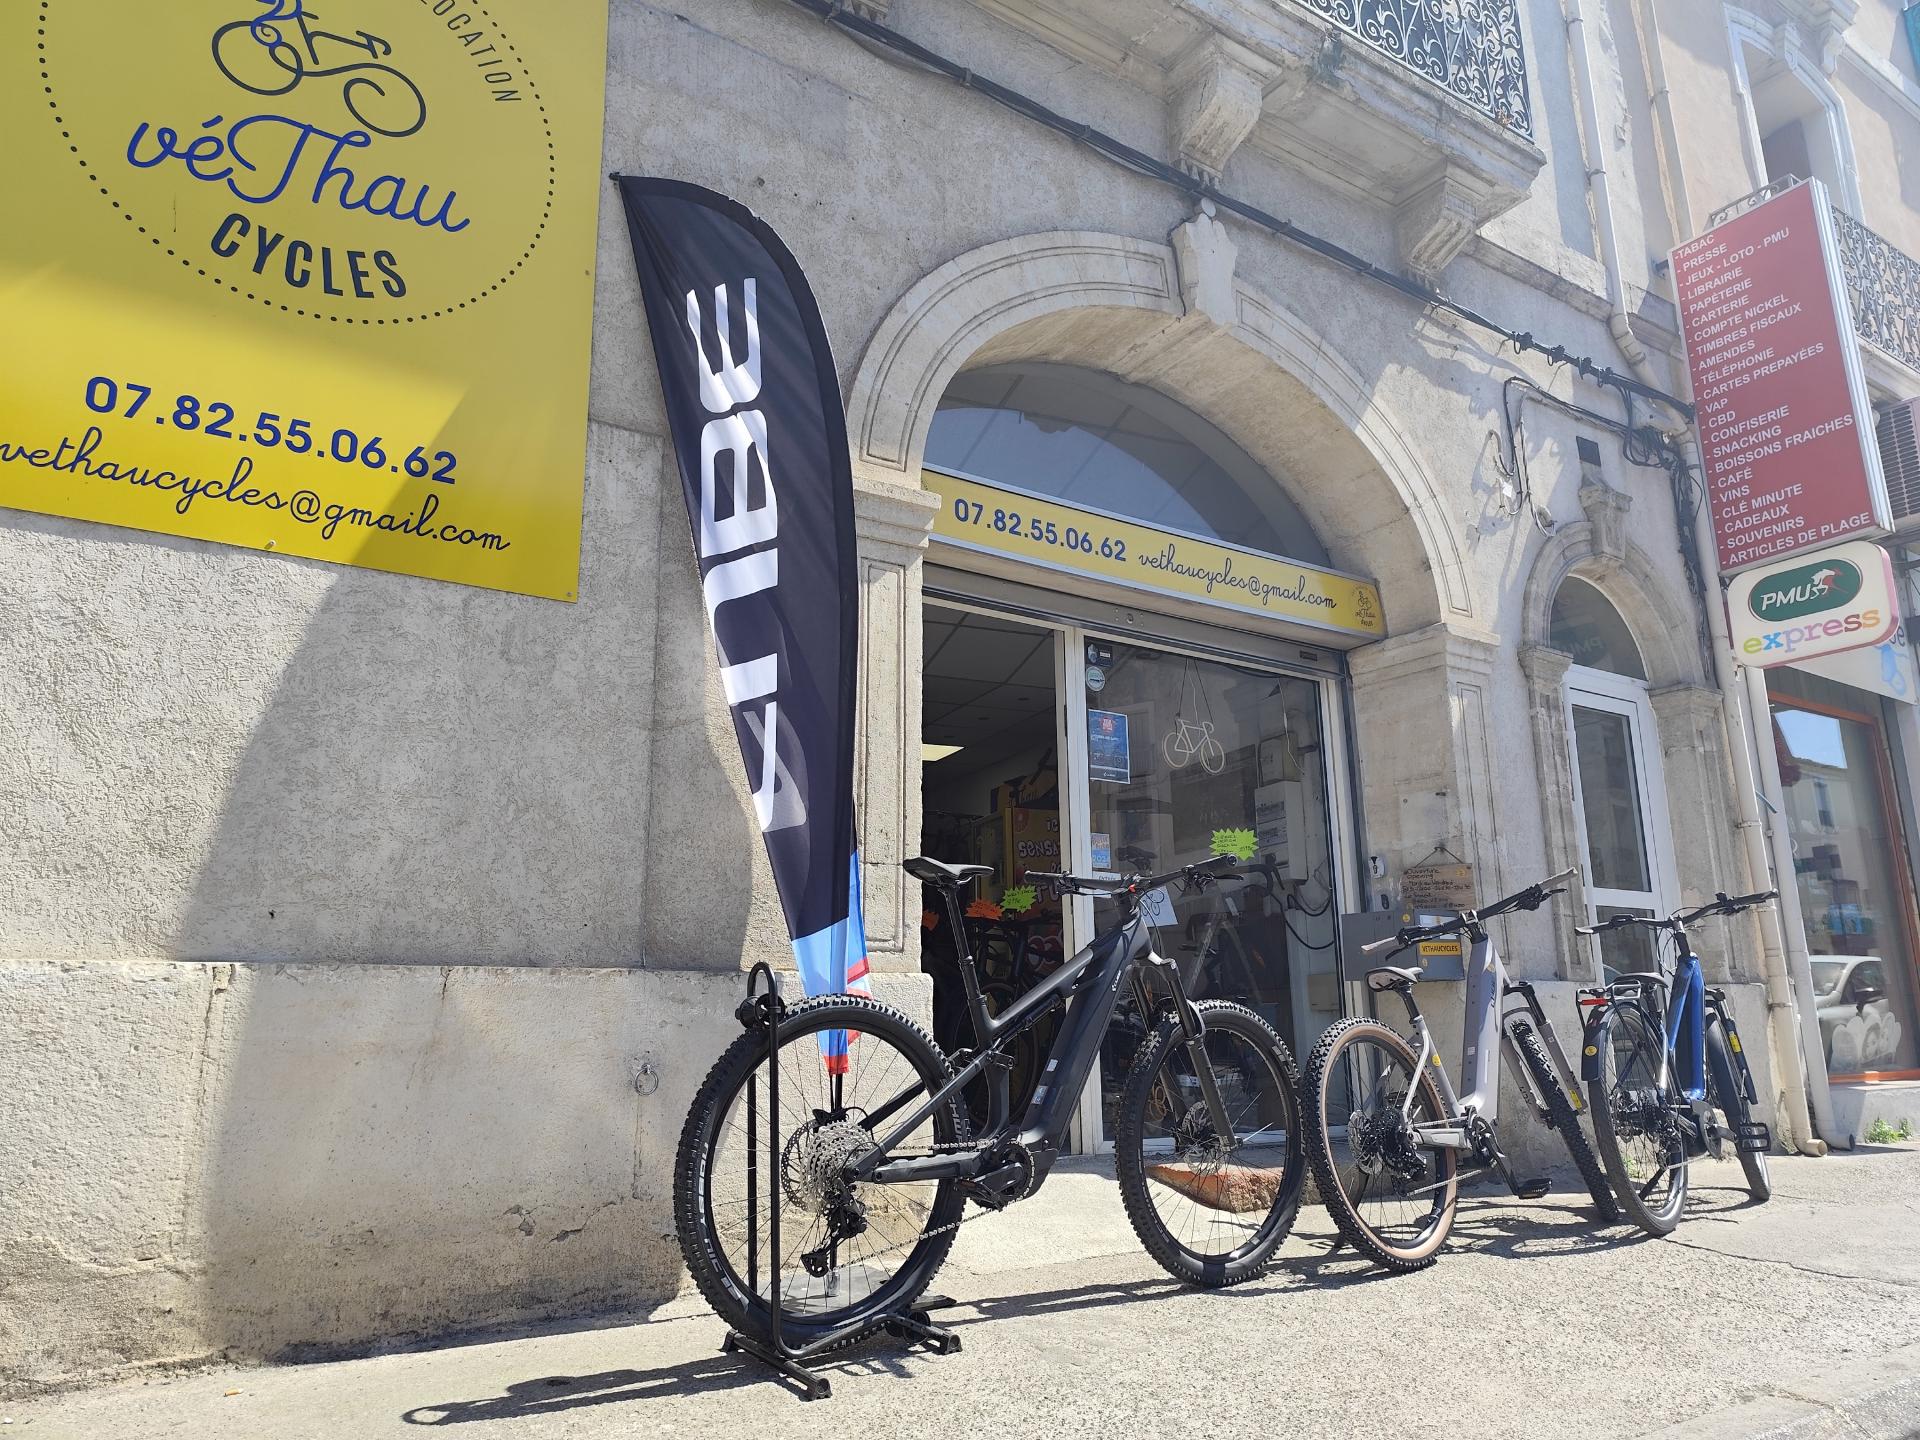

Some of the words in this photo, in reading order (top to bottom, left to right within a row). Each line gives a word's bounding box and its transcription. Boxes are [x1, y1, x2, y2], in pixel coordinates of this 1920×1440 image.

[422, 0, 522, 101] OCATION
[126, 114, 471, 233] véThau
[210, 213, 407, 299] CYCLES
[1683, 244, 1728, 271] PRESSE
[1686, 264, 1714, 286] JEUX
[1723, 245, 1755, 271] LOTO
[1763, 227, 1790, 248] PMU
[1687, 267, 1744, 300] LIBRAIRIE
[1692, 295, 1750, 329] CARTERIE
[1694, 316, 1743, 343] COMPTE
[1745, 295, 1789, 321] NICKEL
[1696, 328, 1748, 357] TIMBRES
[1750, 302, 1802, 333] FISCAUX
[1699, 340, 1756, 372] AMENDES
[1700, 347, 1775, 386] TÉLÉPHONIE
[1703, 374, 1750, 400] CARTES
[1753, 342, 1825, 381] PREPAYÉES
[1705, 398, 1728, 415] VAP
[1708, 411, 1736, 428] CBD
[1711, 405, 1790, 443] CONFISERIE
[85, 376, 458, 485] 07.82.55.06.62
[1713, 425, 1782, 458] SNACKING
[1715, 442, 1782, 474] BOISSONS
[1784, 413, 1854, 451] FRAICHES
[0, 426, 511, 552] vethaucycles@gmail.com
[1717, 467, 1753, 488] CAFÉ
[1720, 485, 1750, 502] VINS
[1722, 499, 1749, 519] CLÉ
[1751, 483, 1803, 509] MINUTE
[1724, 504, 1790, 534] CADEAUX
[954, 498, 1127, 562] 07.82.55.06.62
[1727, 516, 1805, 550] SOUVENIRS
[1729, 537, 1795, 566] ARTICLES
[1798, 529, 1818, 544] DE
[1821, 512, 1870, 538] PLAGE
[1138, 543, 1337, 611] vethaucycles@gmail.com
[1760, 583, 1812, 611] PMU
[1743, 609, 1881, 654] express
